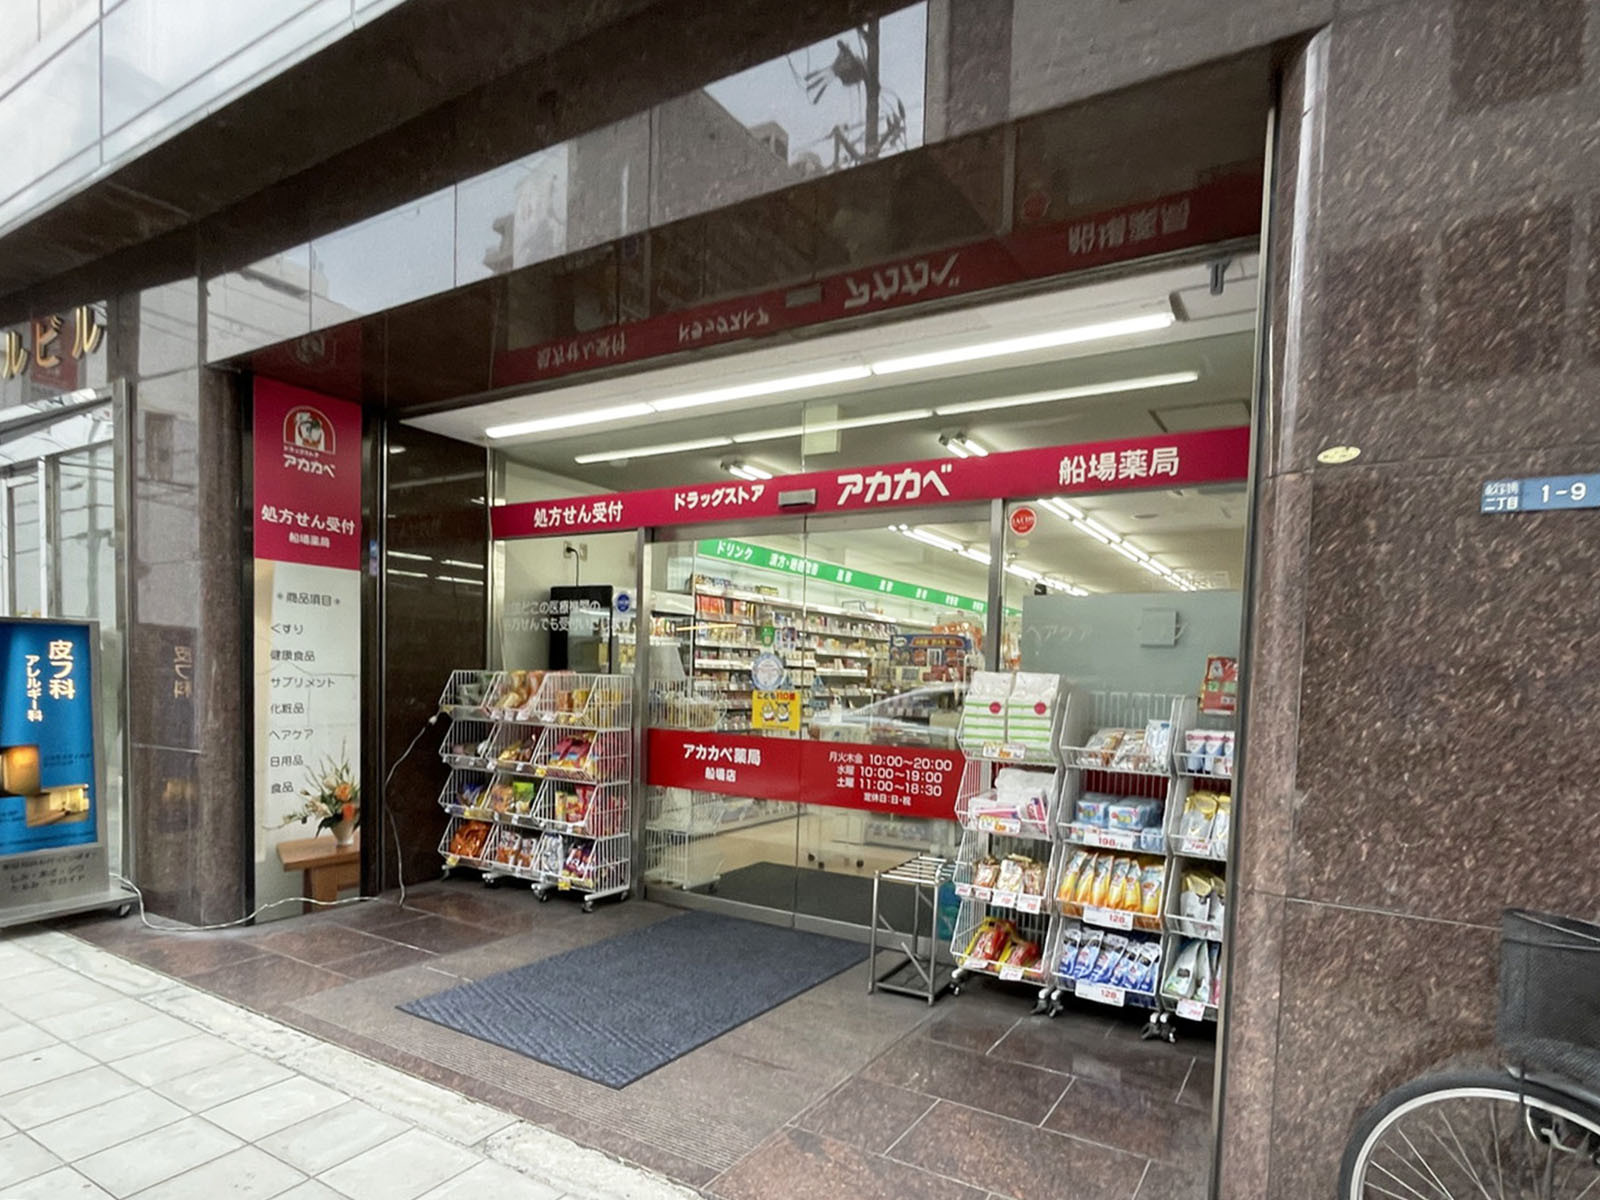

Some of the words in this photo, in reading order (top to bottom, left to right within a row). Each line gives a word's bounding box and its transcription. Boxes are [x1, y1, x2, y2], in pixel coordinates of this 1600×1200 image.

[282, 453, 336, 478] アカカベ
[1059, 447, 1180, 485] 船場薬局
[836, 464, 952, 505] アカカベ
[1541, 482, 1587, 503] 1-9
[674, 484, 765, 511] ドラッグストア
[1484, 496, 1518, 511] 二丁目
[261, 504, 356, 536] 処方せん受付
[533, 500, 623, 528] 処方せん受付
[717, 540, 753, 561] ドリンク
[270, 624, 304, 635] くすり
[270, 650, 315, 662] 健康食品
[49, 639, 76, 700] 皮フ科
[25, 654, 43, 722] アレルギー科
[270, 677, 336, 689] サプリメント
[270, 702, 305, 715] 化粧品
[269, 728, 314, 740] ヘアケア
[270, 755, 304, 767] 日用品
[682, 743, 761, 767] アカカベ薬局
[270, 782, 294, 794] 食品
